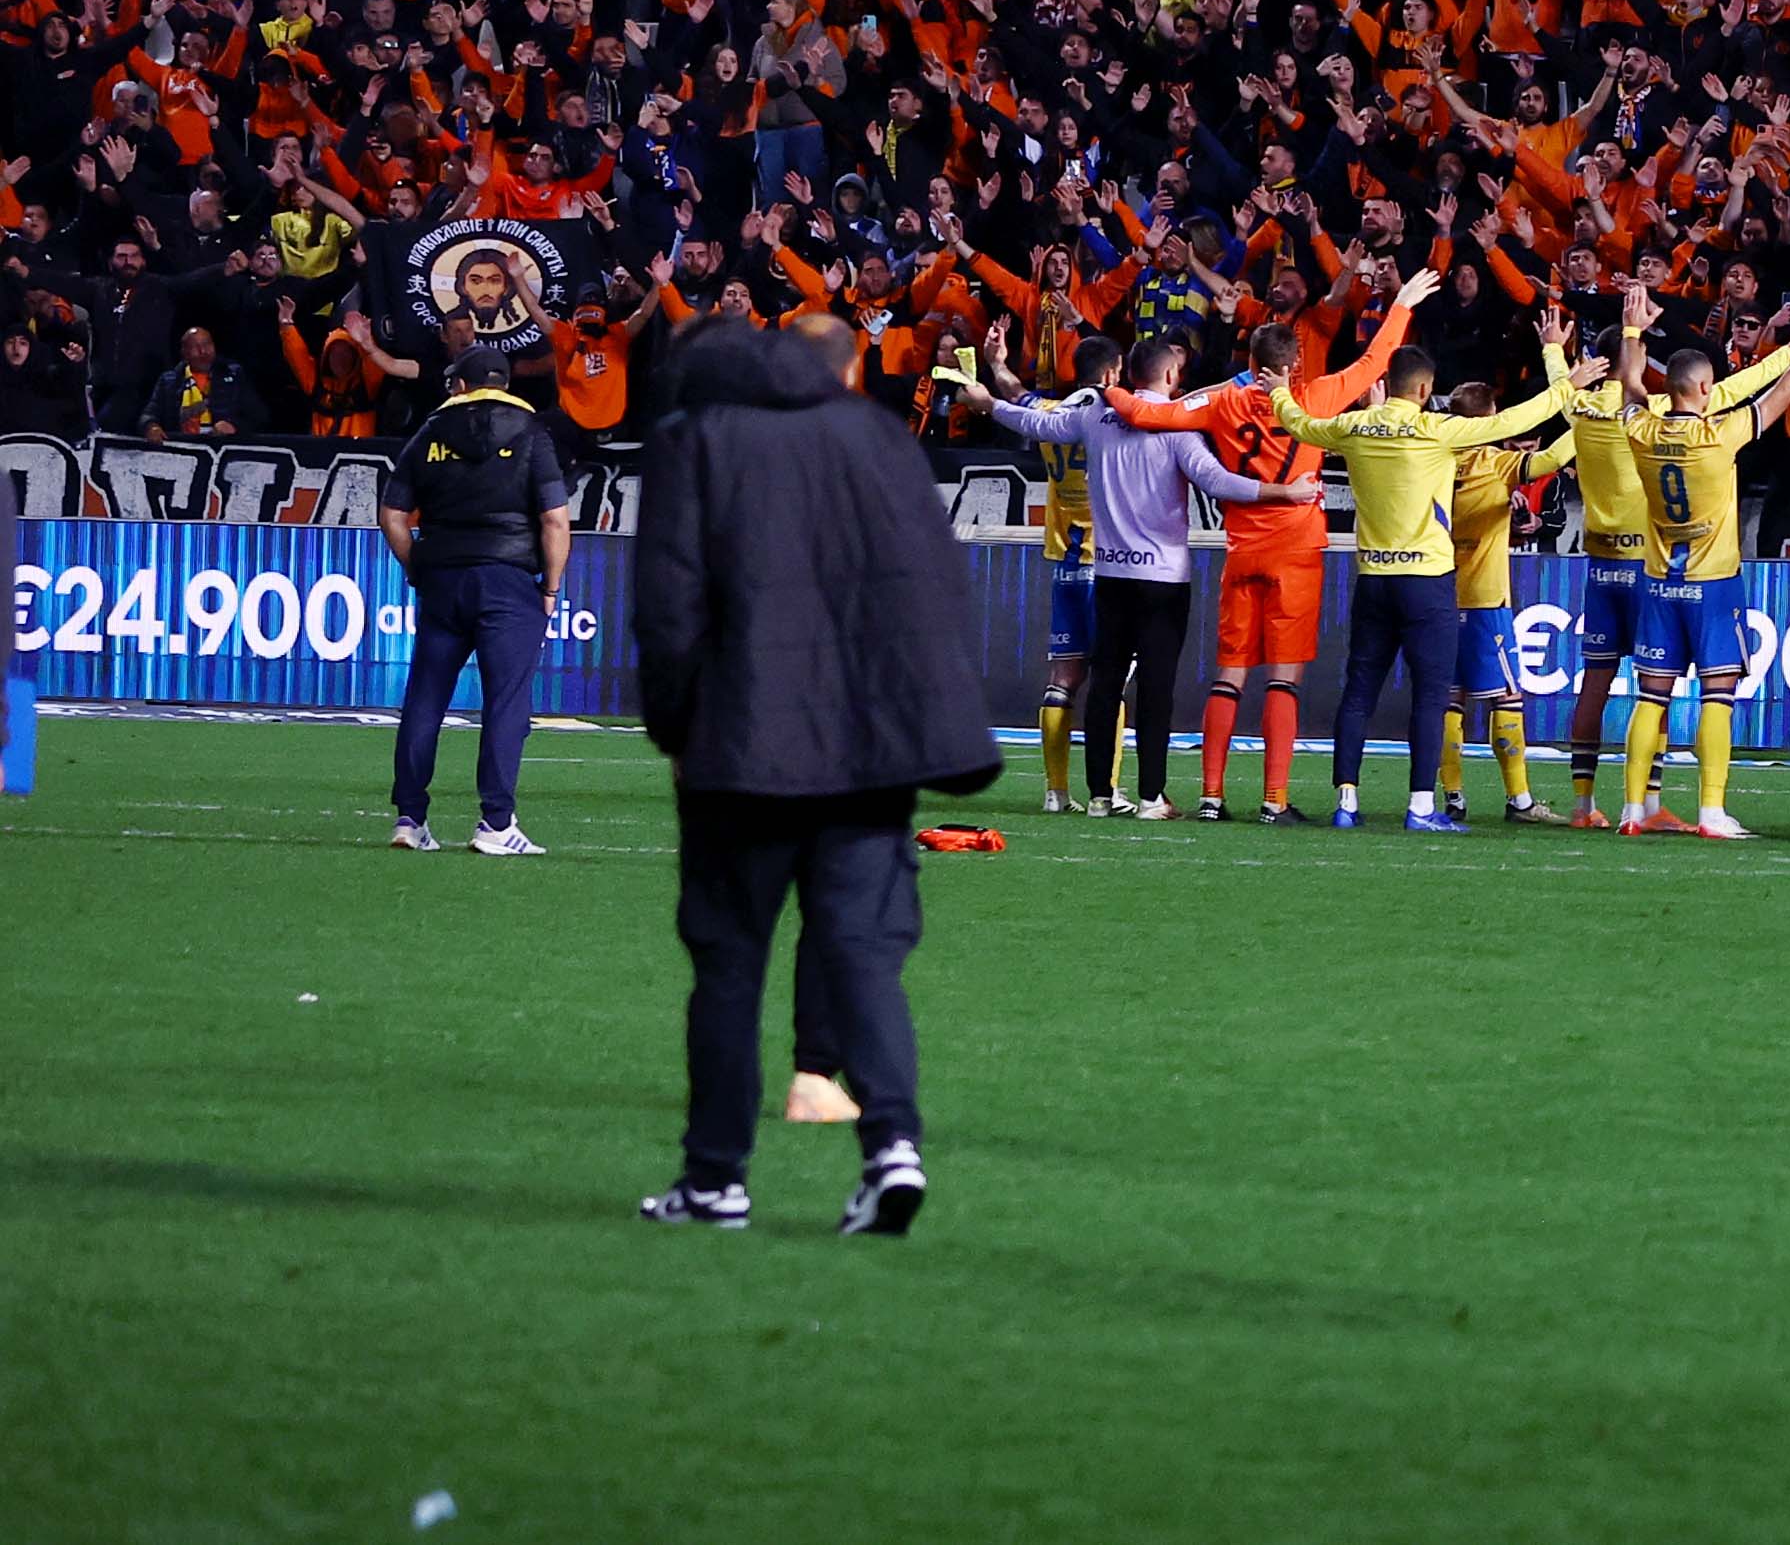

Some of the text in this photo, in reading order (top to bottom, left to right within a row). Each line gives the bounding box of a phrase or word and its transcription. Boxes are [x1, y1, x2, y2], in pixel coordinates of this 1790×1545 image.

[1350, 424, 1416, 437] APOEL FC
[1237, 422, 1298, 485] 27
[1659, 463, 1691, 524] 9
[1095, 547, 1155, 566] macron
